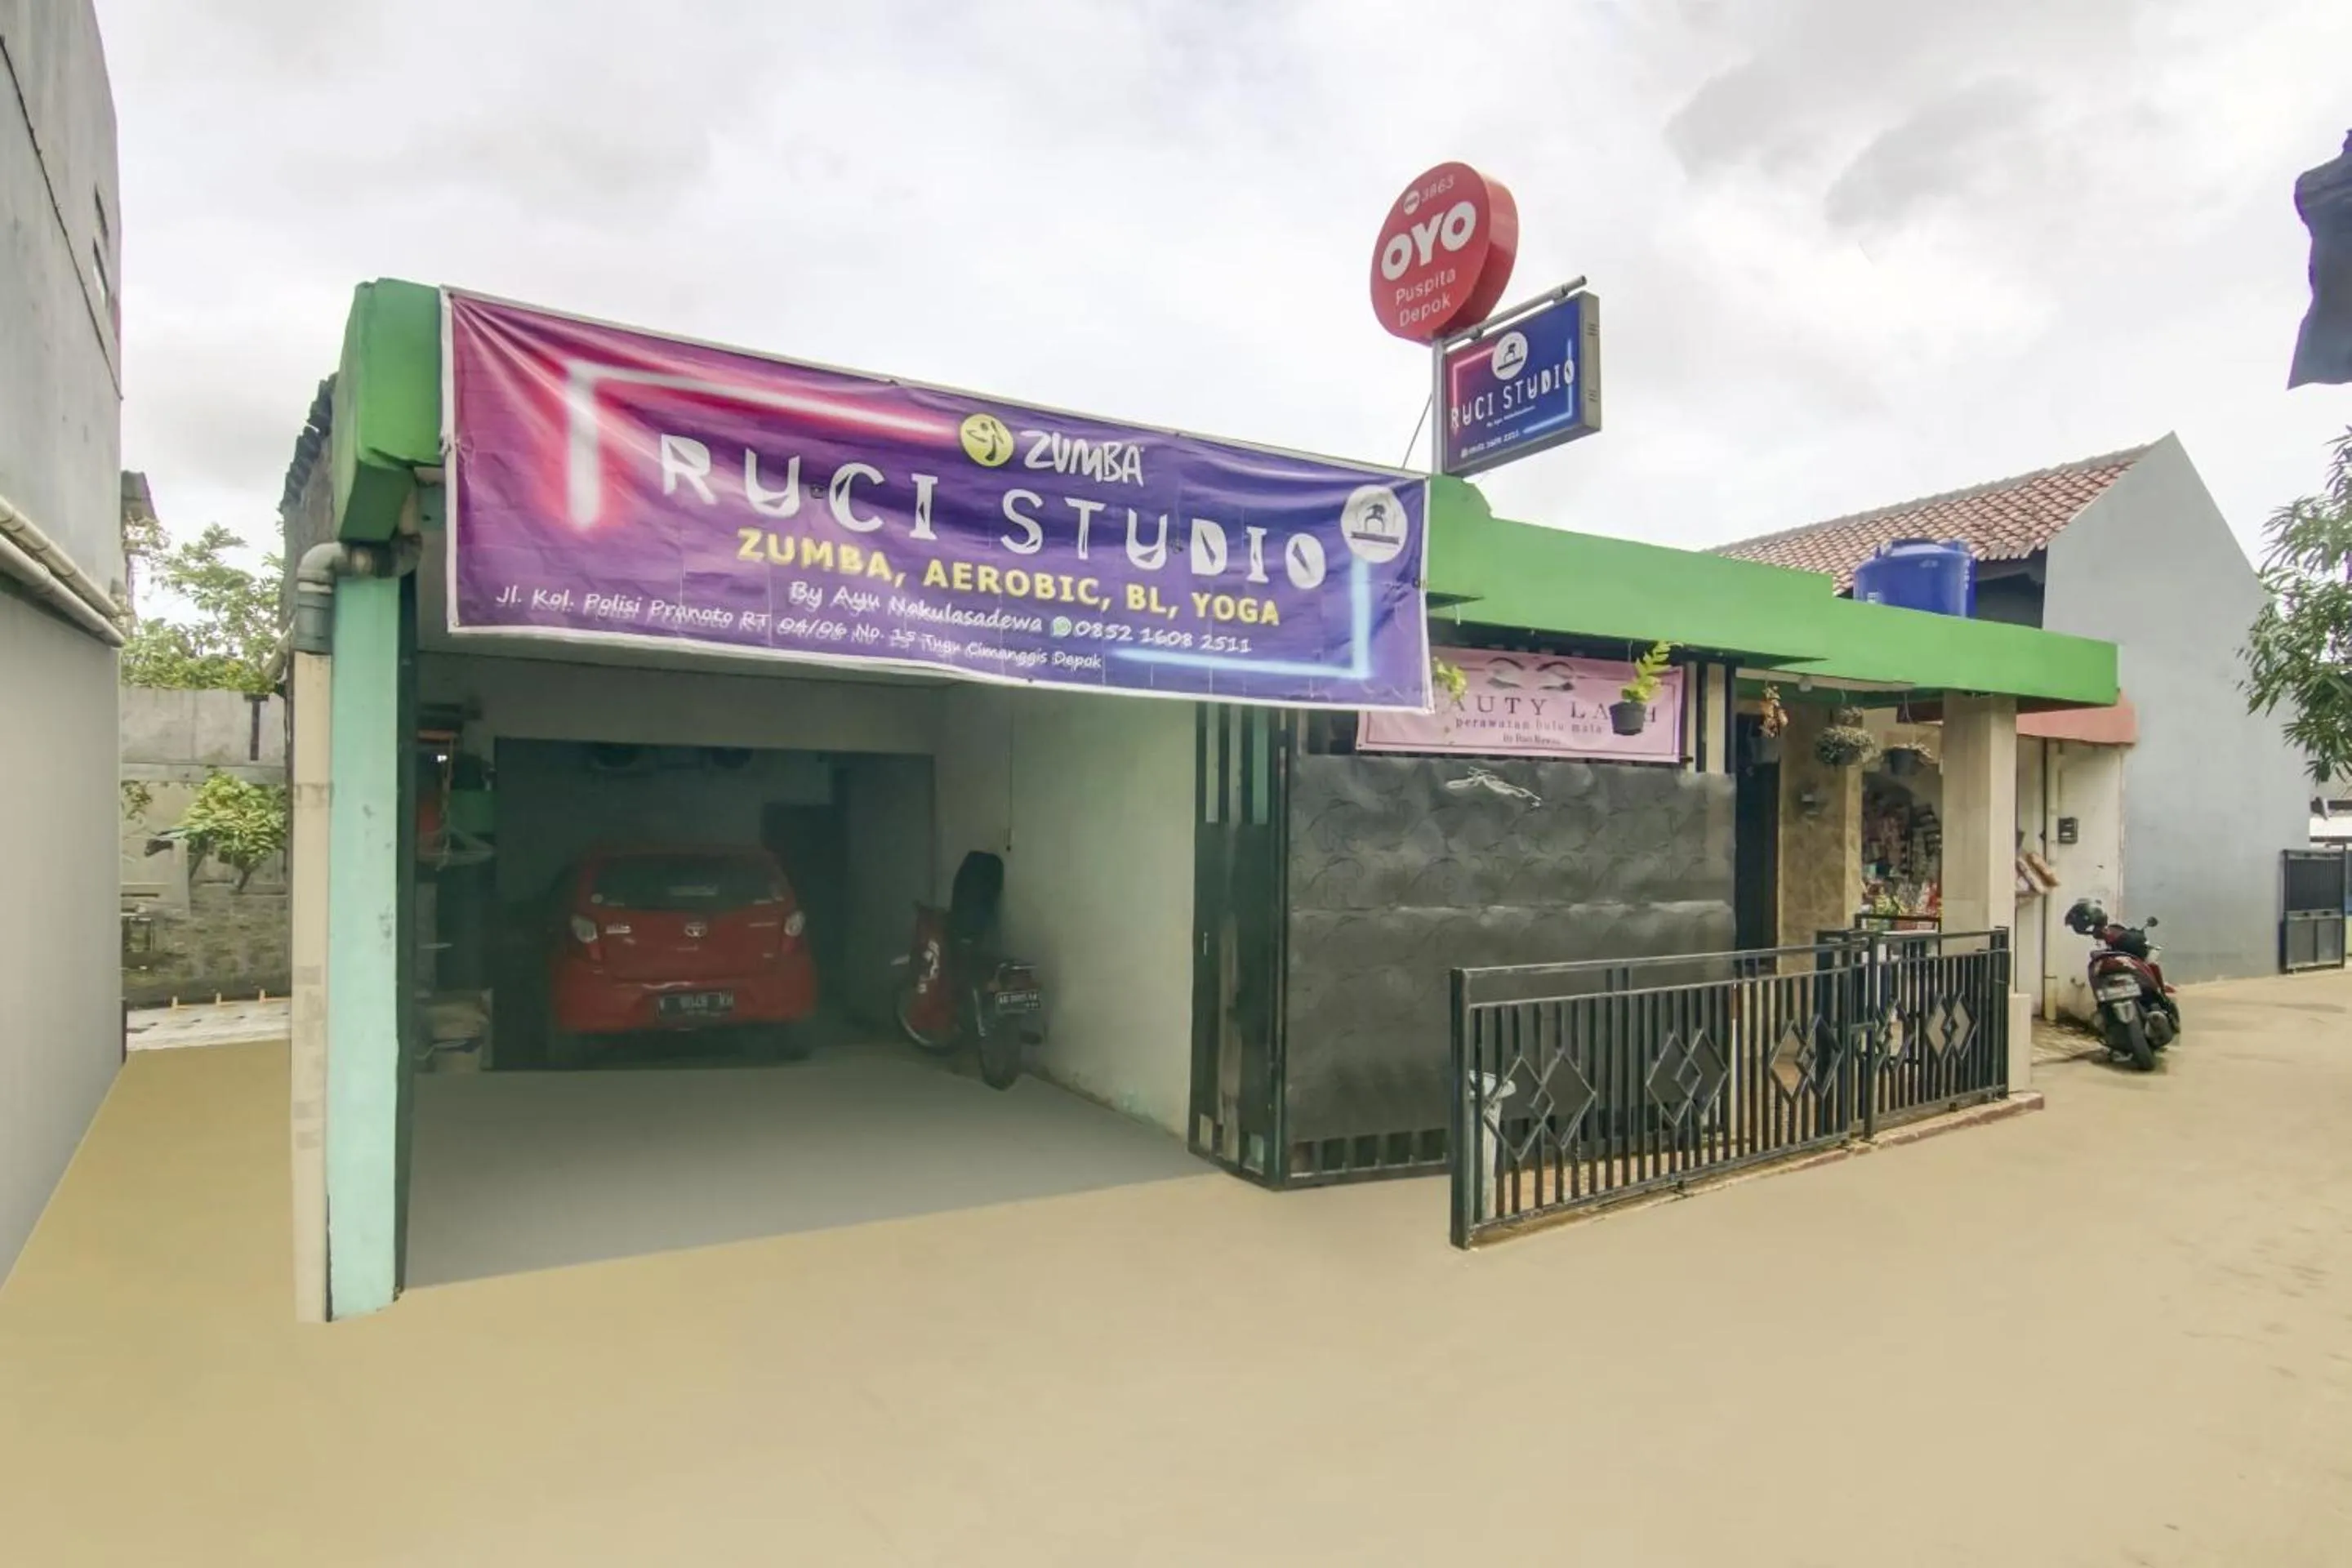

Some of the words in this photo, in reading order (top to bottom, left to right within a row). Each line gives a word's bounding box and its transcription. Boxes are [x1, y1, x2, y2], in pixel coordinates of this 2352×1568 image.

[1381, 201, 1477, 281] OYO
[1395, 269, 1456, 305] Puspita
[1399, 293, 1451, 327] Depok
[1450, 392, 1494, 429] RUCI
[1503, 359, 1575, 409] STUDIO
[1020, 430, 1144, 488] ZUMBA
[660, 434, 939, 541] RUCI
[1000, 488, 1326, 590] STUDIO
[737, 528, 906, 588] ZUMBA,
[923, 559, 1111, 612] AEROBIC,
[1125, 584, 1178, 620] BL,
[1192, 592, 1280, 626] YOGA
[496, 585, 523, 605] Jl.
[532, 589, 574, 612] Kol.
[583, 593, 644, 621] Polisi
[647, 599, 733, 629] Pranoto
[738, 611, 772, 632] RT
[777, 617, 848, 640] 04/06
[850, 622, 884, 644] No.
[965, 642, 1047, 668] Cimanggis
[789, 581, 822, 612] By
[829, 586, 880, 617] Ayu
[1075, 621, 1133, 642] 0852
[1140, 626, 1193, 648] 1608
[1198, 634, 1251, 653] 2511
[1570, 701, 1658, 724] LAH
